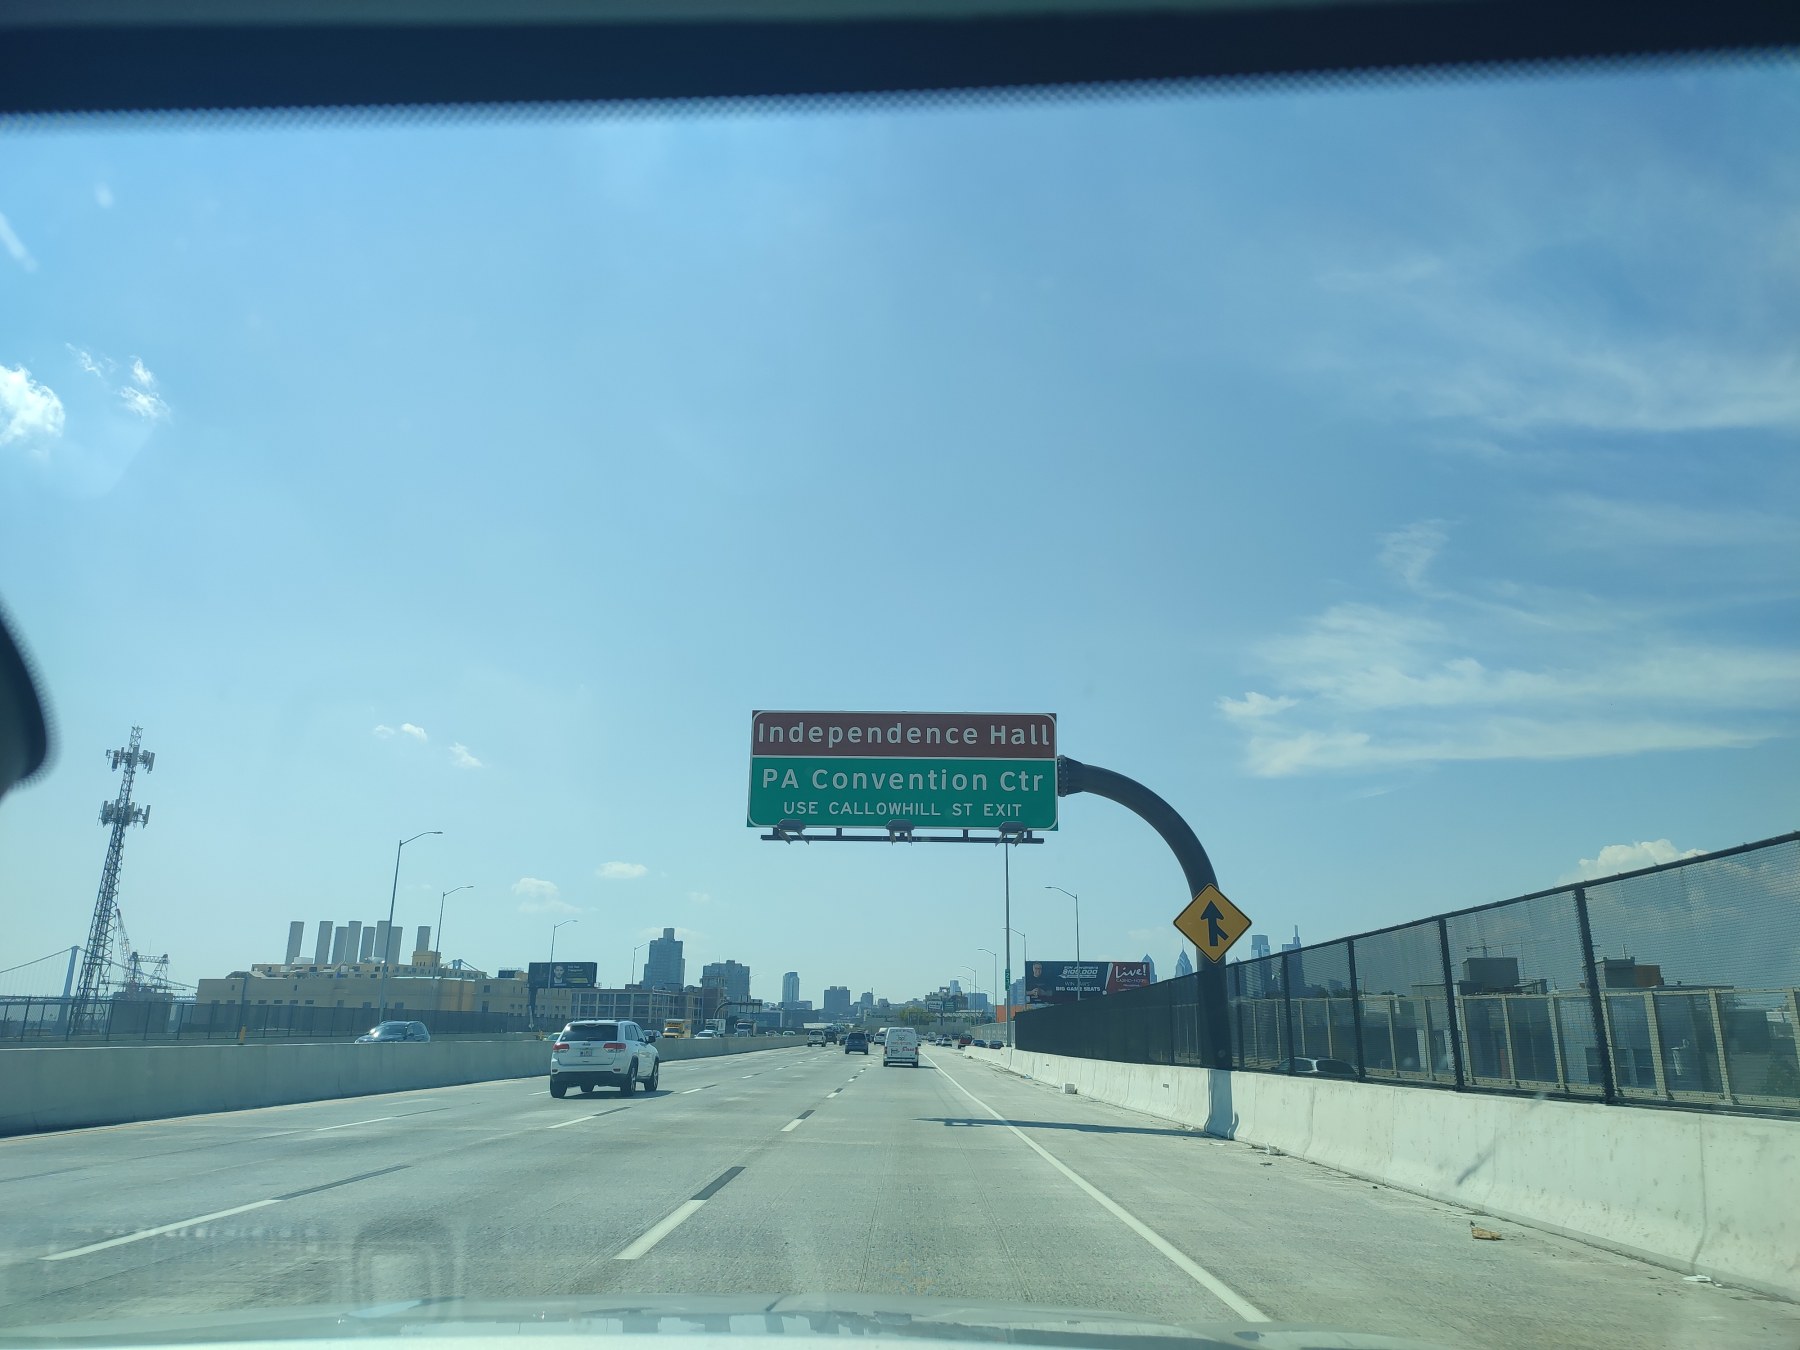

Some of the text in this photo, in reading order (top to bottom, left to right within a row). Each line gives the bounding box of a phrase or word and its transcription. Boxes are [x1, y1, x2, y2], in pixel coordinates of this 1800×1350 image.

[758, 722, 1050, 748] Independence Hall
[762, 768, 1044, 792] PA Convention Ctr
[783, 801, 1022, 817] USE CALLOWHILL ST EXIT
[1115, 964, 1147, 979] Live!
